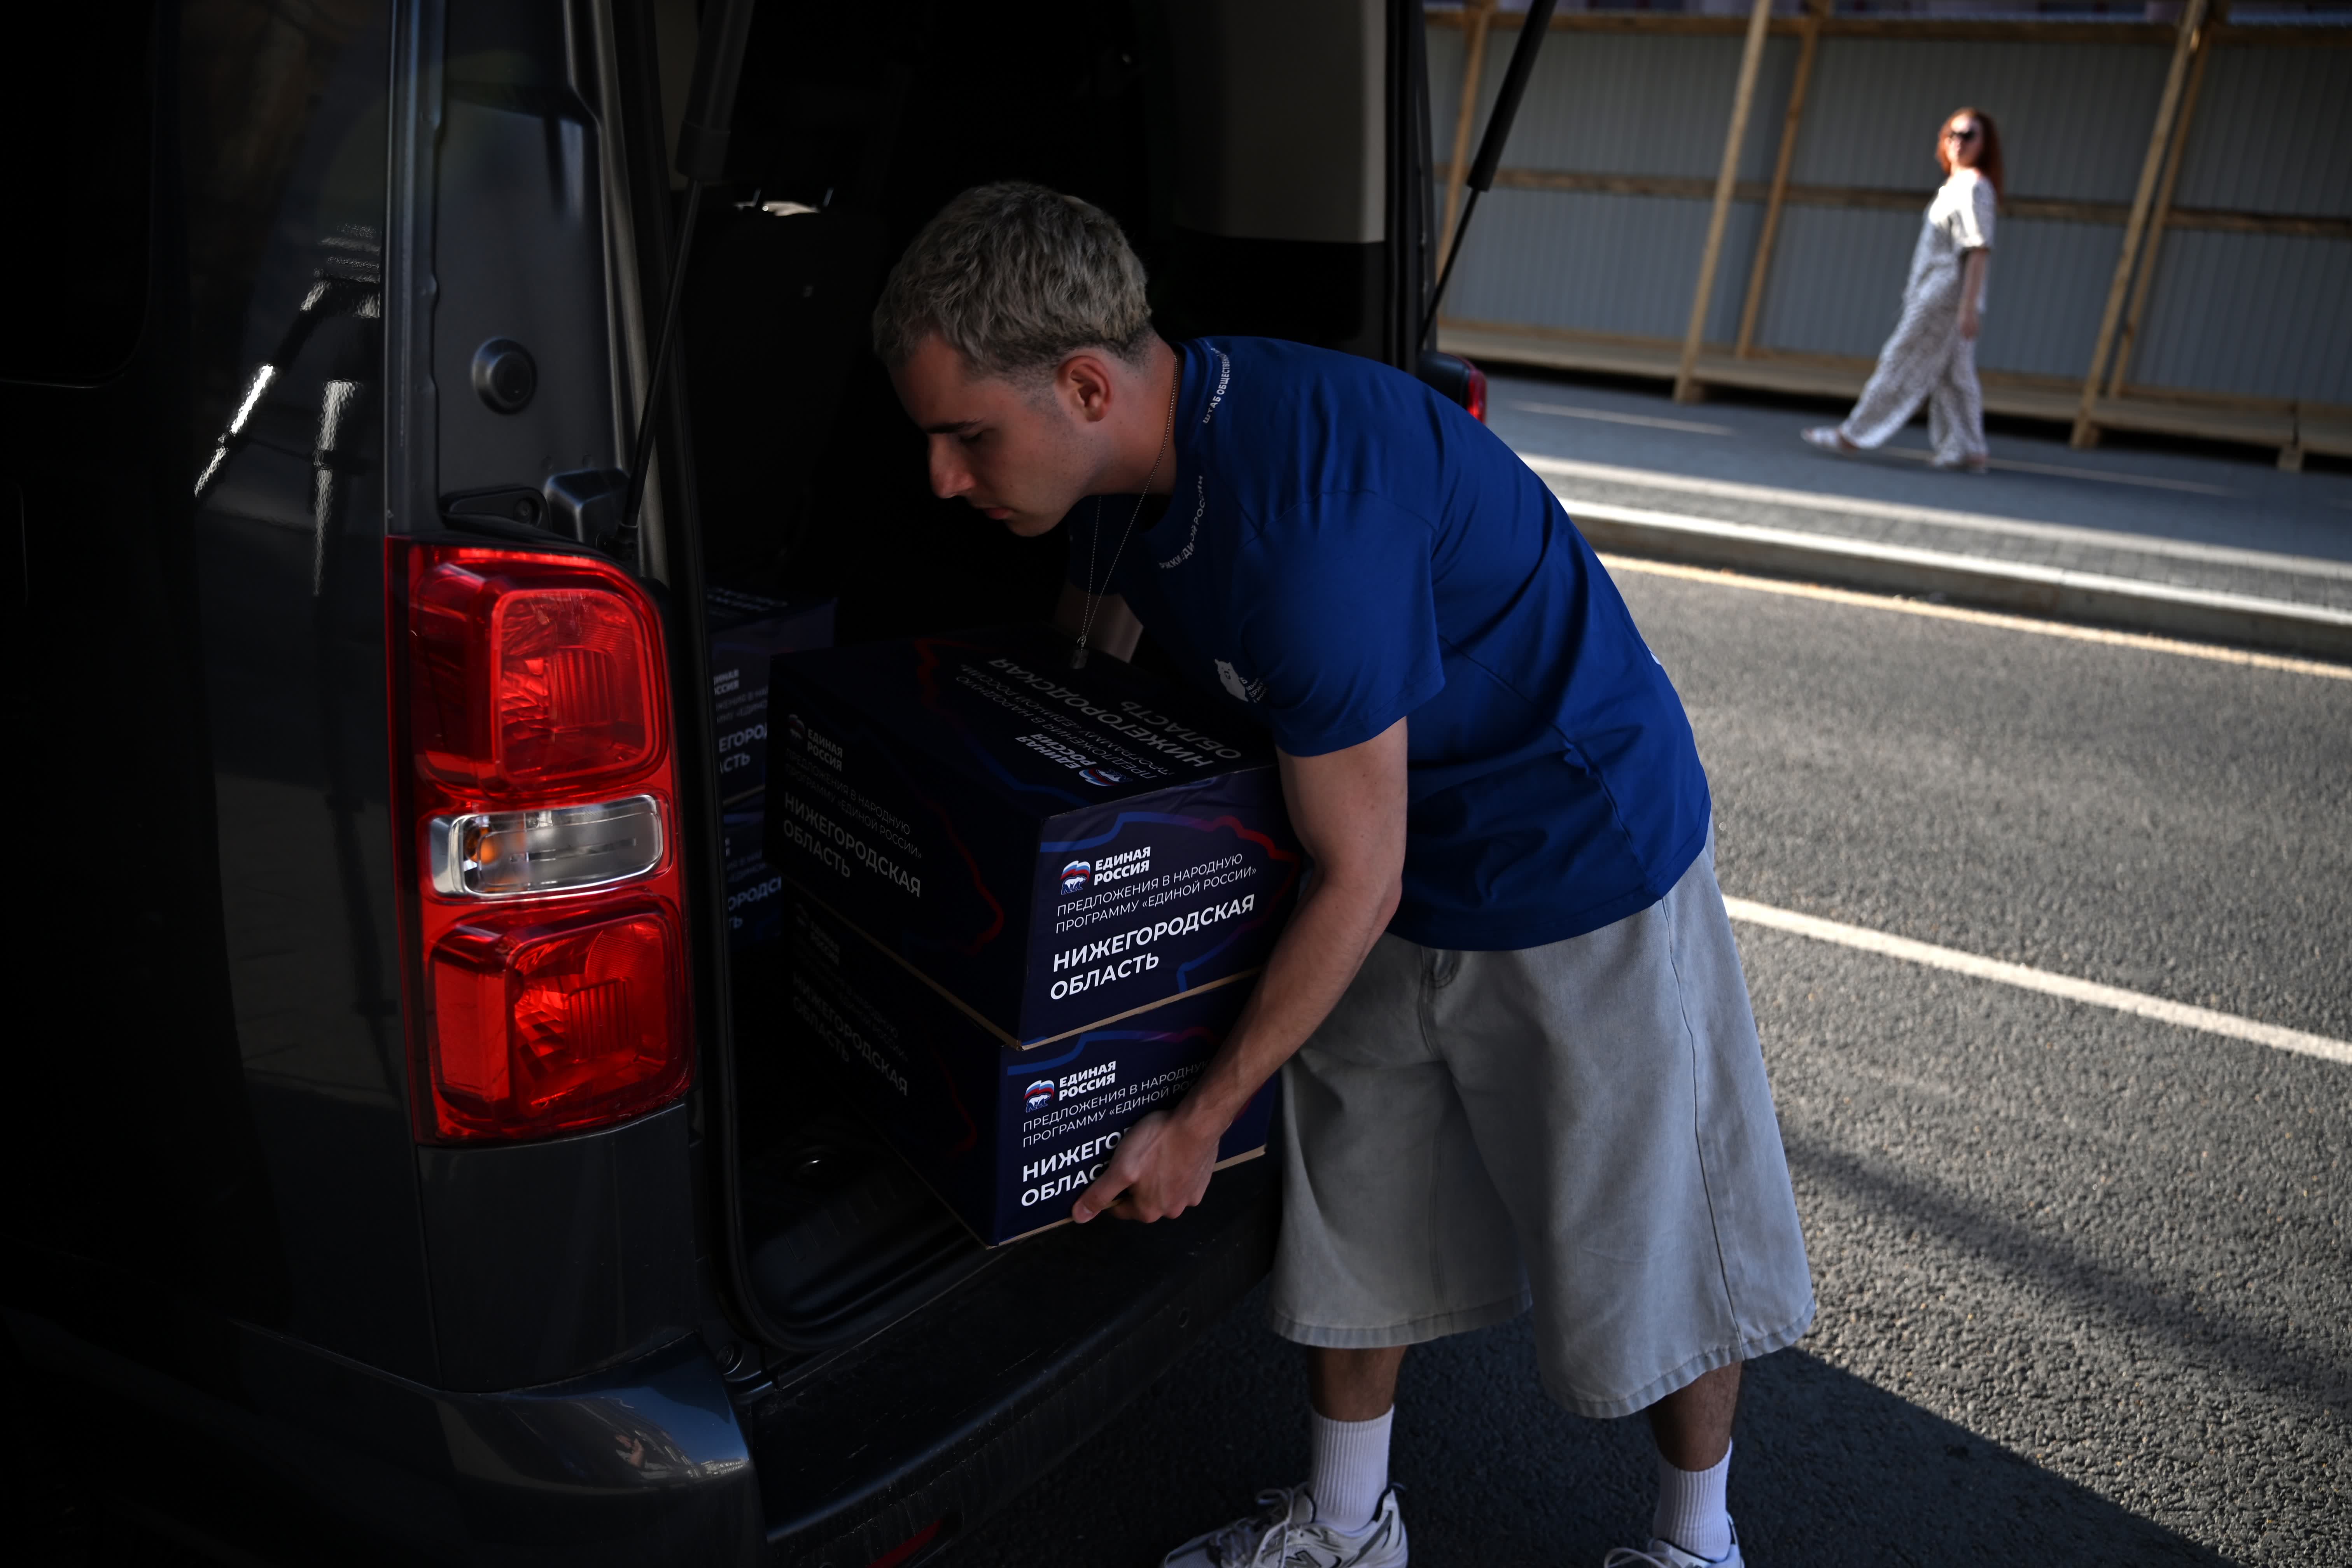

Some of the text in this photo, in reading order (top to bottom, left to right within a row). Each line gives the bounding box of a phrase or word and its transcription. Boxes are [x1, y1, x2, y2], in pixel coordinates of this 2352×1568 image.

[1202, 396, 1222, 424] ШТАБ
[988, 658, 1215, 768] НИЖЕГОРОДСКАЯ
[1120, 700, 1242, 760] ОБЛАСТЬ
[806, 741, 842, 772] РОССИЯ
[807, 728, 843, 759] ЕДИНАЯ
[1014, 736, 1082, 769] ЕДИНАЯ
[1030, 733, 1097, 766] РОССИЯ
[1042, 723, 1158, 779] ПРЕДЛОЖЕНИЯ
[1078, 730, 1176, 775] ПРОГРАММУ
[858, 793, 911, 835] НАРОДНУЮ
[783, 819, 851, 878] ОБЛАСТЬ
[784, 791, 921, 899] НИЖЕГОРОДСКАЯ
[880, 825, 922, 859] РОССИИ»
[1094, 846, 1151, 872] ЕДИНАЯ
[1057, 853, 1243, 917] ПРЕДЛОЖЕНИЯ В НАРОДНУЮ
[1094, 860, 1150, 886] РОССИЯ
[1055, 866, 1257, 934] ПРОГРАММУ «ЕДИНОЙ РОССИИ»
[1052, 893, 1255, 973] НИЖЕГОРОДСКАЯ
[1050, 952, 1160, 1000] ОБЛАСТЬ
[1059, 1060, 1116, 1088] ЕДИНАЯ
[1059, 1073, 1116, 1101] РОССИЯ
[1022, 1109, 1106, 1148] ПРОГРАММУ
[1109, 1085, 1170, 1117] «ЕДИНОЙ
[1023, 1087, 1126, 1133] ПРЕДЛОЖЕНИЯ
[1130, 1083, 1138, 1096] В
[1022, 1126, 1132, 1183] НИЖЕГО
[1020, 1160, 1109, 1207] ОБЛАС
